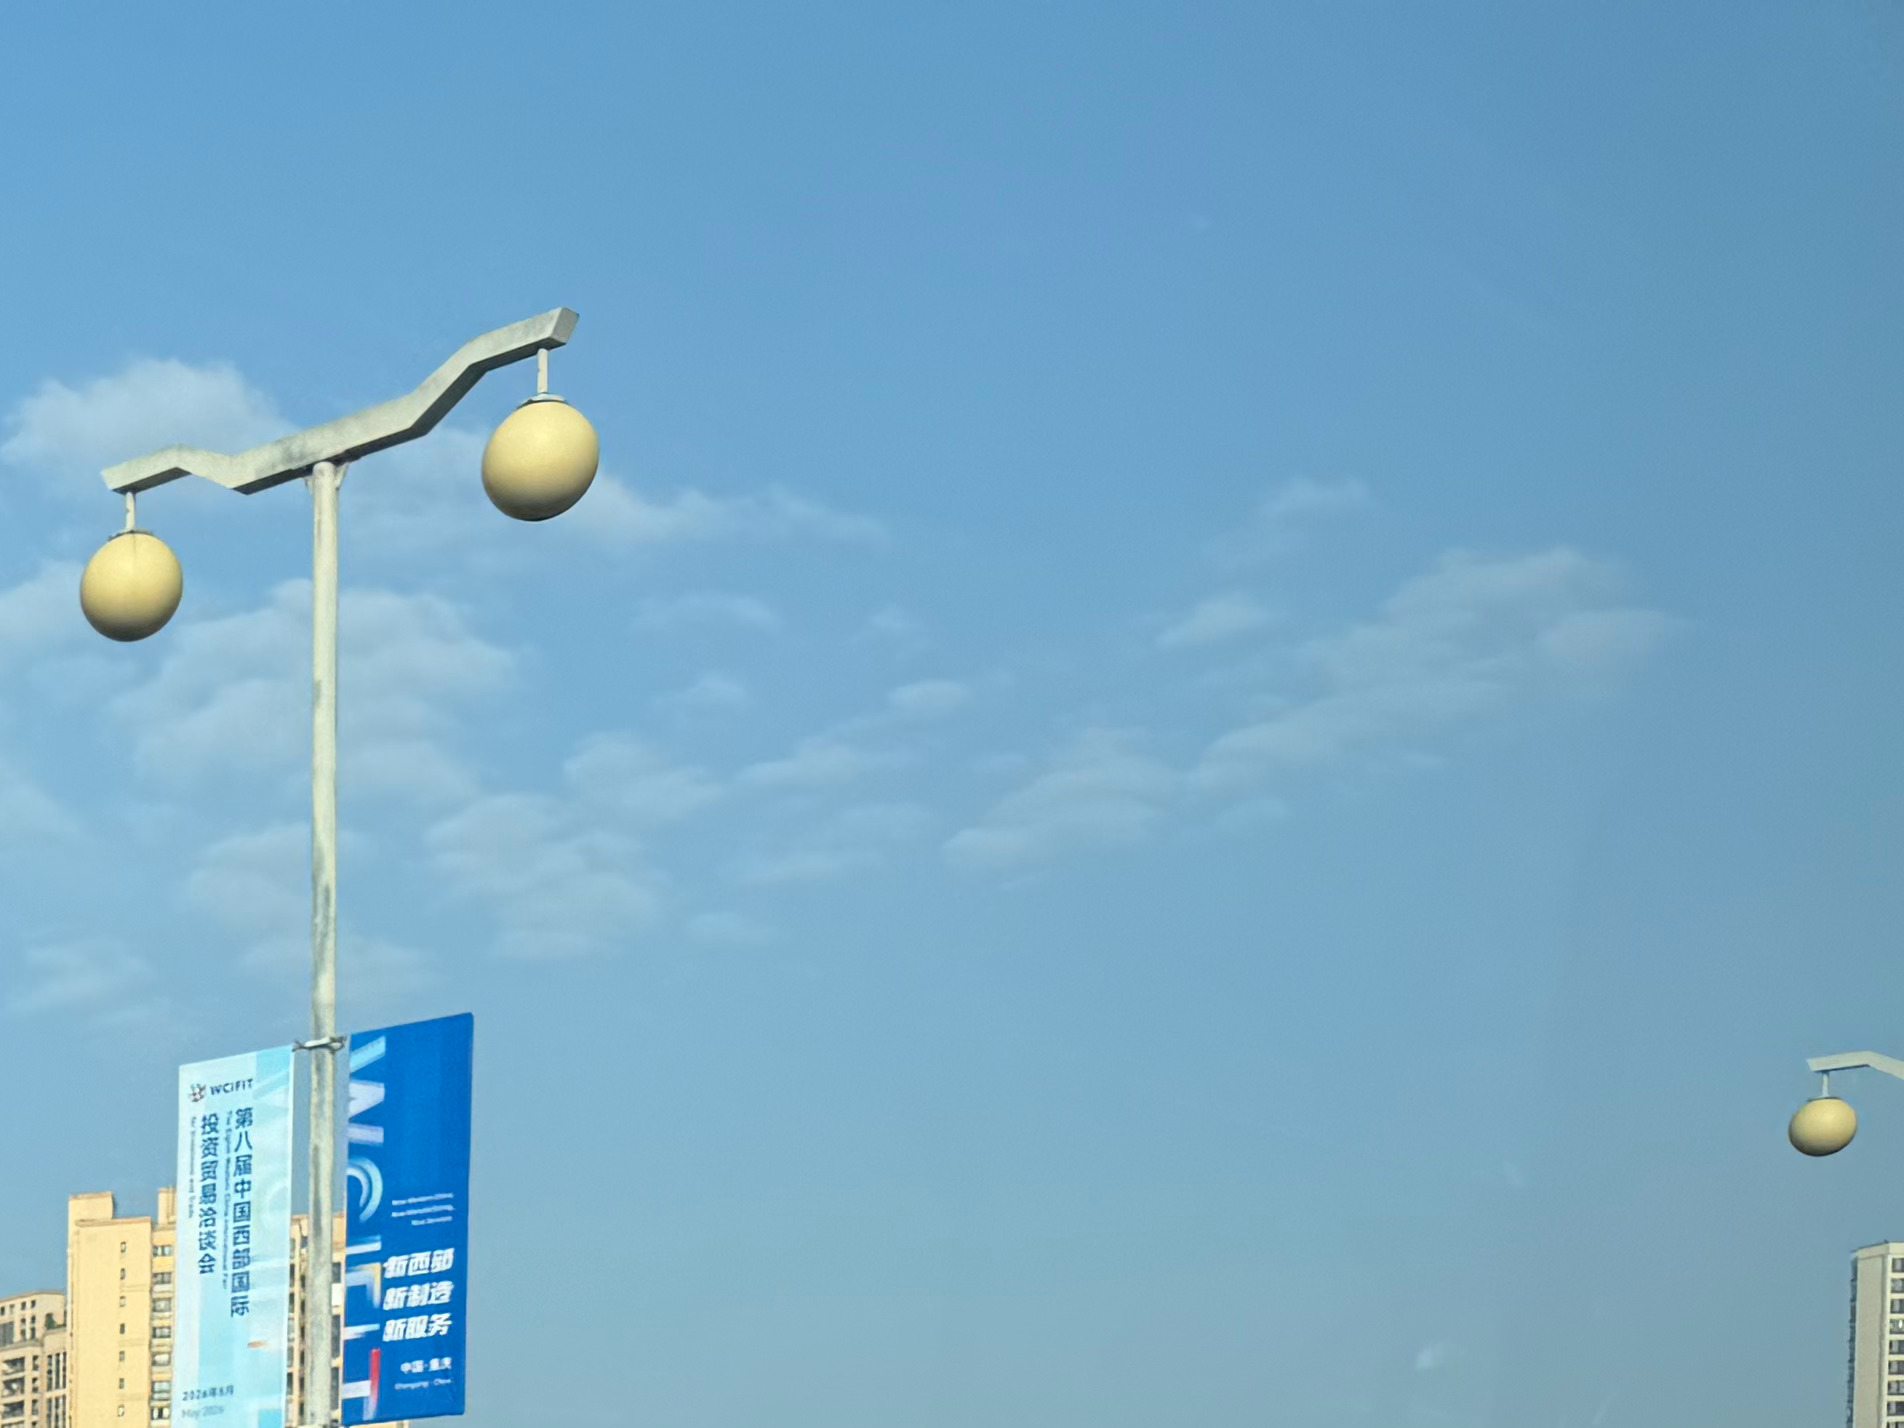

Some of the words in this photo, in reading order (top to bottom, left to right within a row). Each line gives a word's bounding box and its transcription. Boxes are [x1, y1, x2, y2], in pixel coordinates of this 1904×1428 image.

[231, 1106, 254, 1318] 第八届中国西部国际
[383, 1247, 455, 1279] 新西部
[382, 1280, 455, 1311] 新制造
[382, 1312, 453, 1342] 新服务
